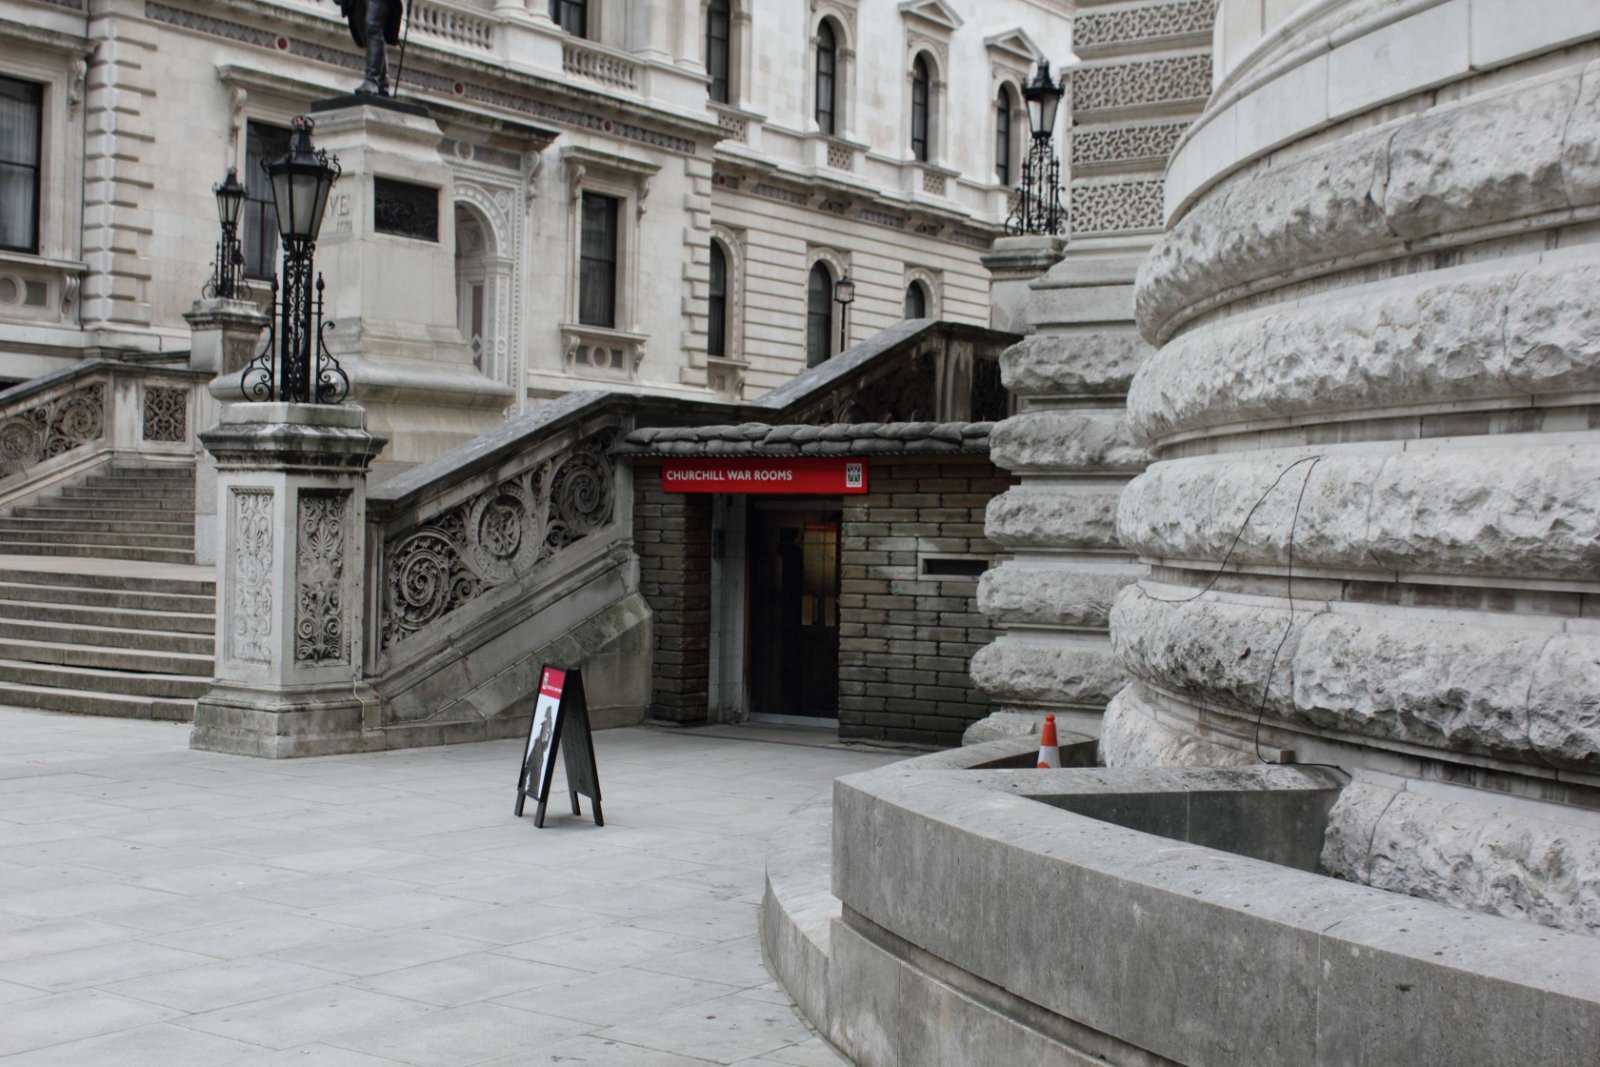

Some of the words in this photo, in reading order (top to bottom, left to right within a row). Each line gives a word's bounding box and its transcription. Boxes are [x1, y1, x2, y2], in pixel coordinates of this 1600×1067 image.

[666, 470, 725, 480] CHURCHILL
[727, 470, 752, 480] WAR
[754, 470, 793, 480] ROOMS
